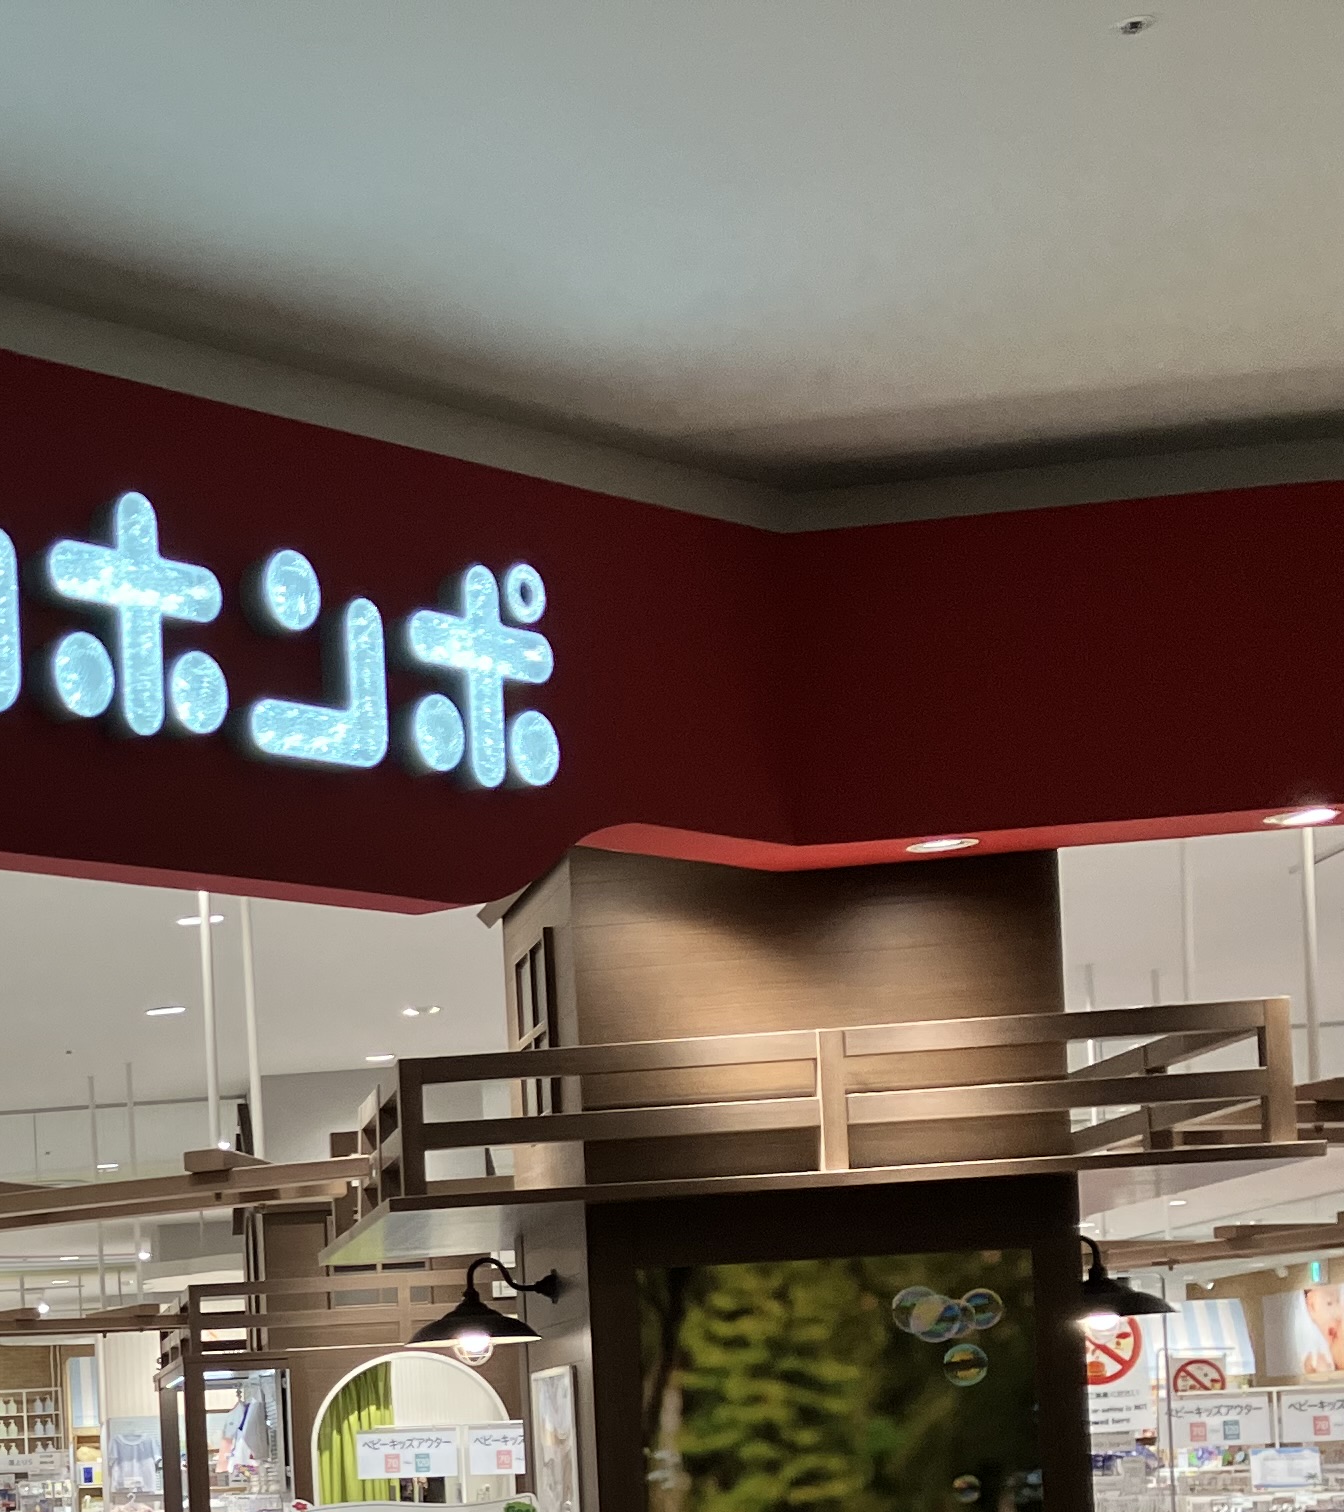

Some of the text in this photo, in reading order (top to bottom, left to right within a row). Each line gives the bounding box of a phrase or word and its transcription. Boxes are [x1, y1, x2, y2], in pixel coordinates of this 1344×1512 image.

[362, 1436, 452, 1450] ベビーキッズアウター
